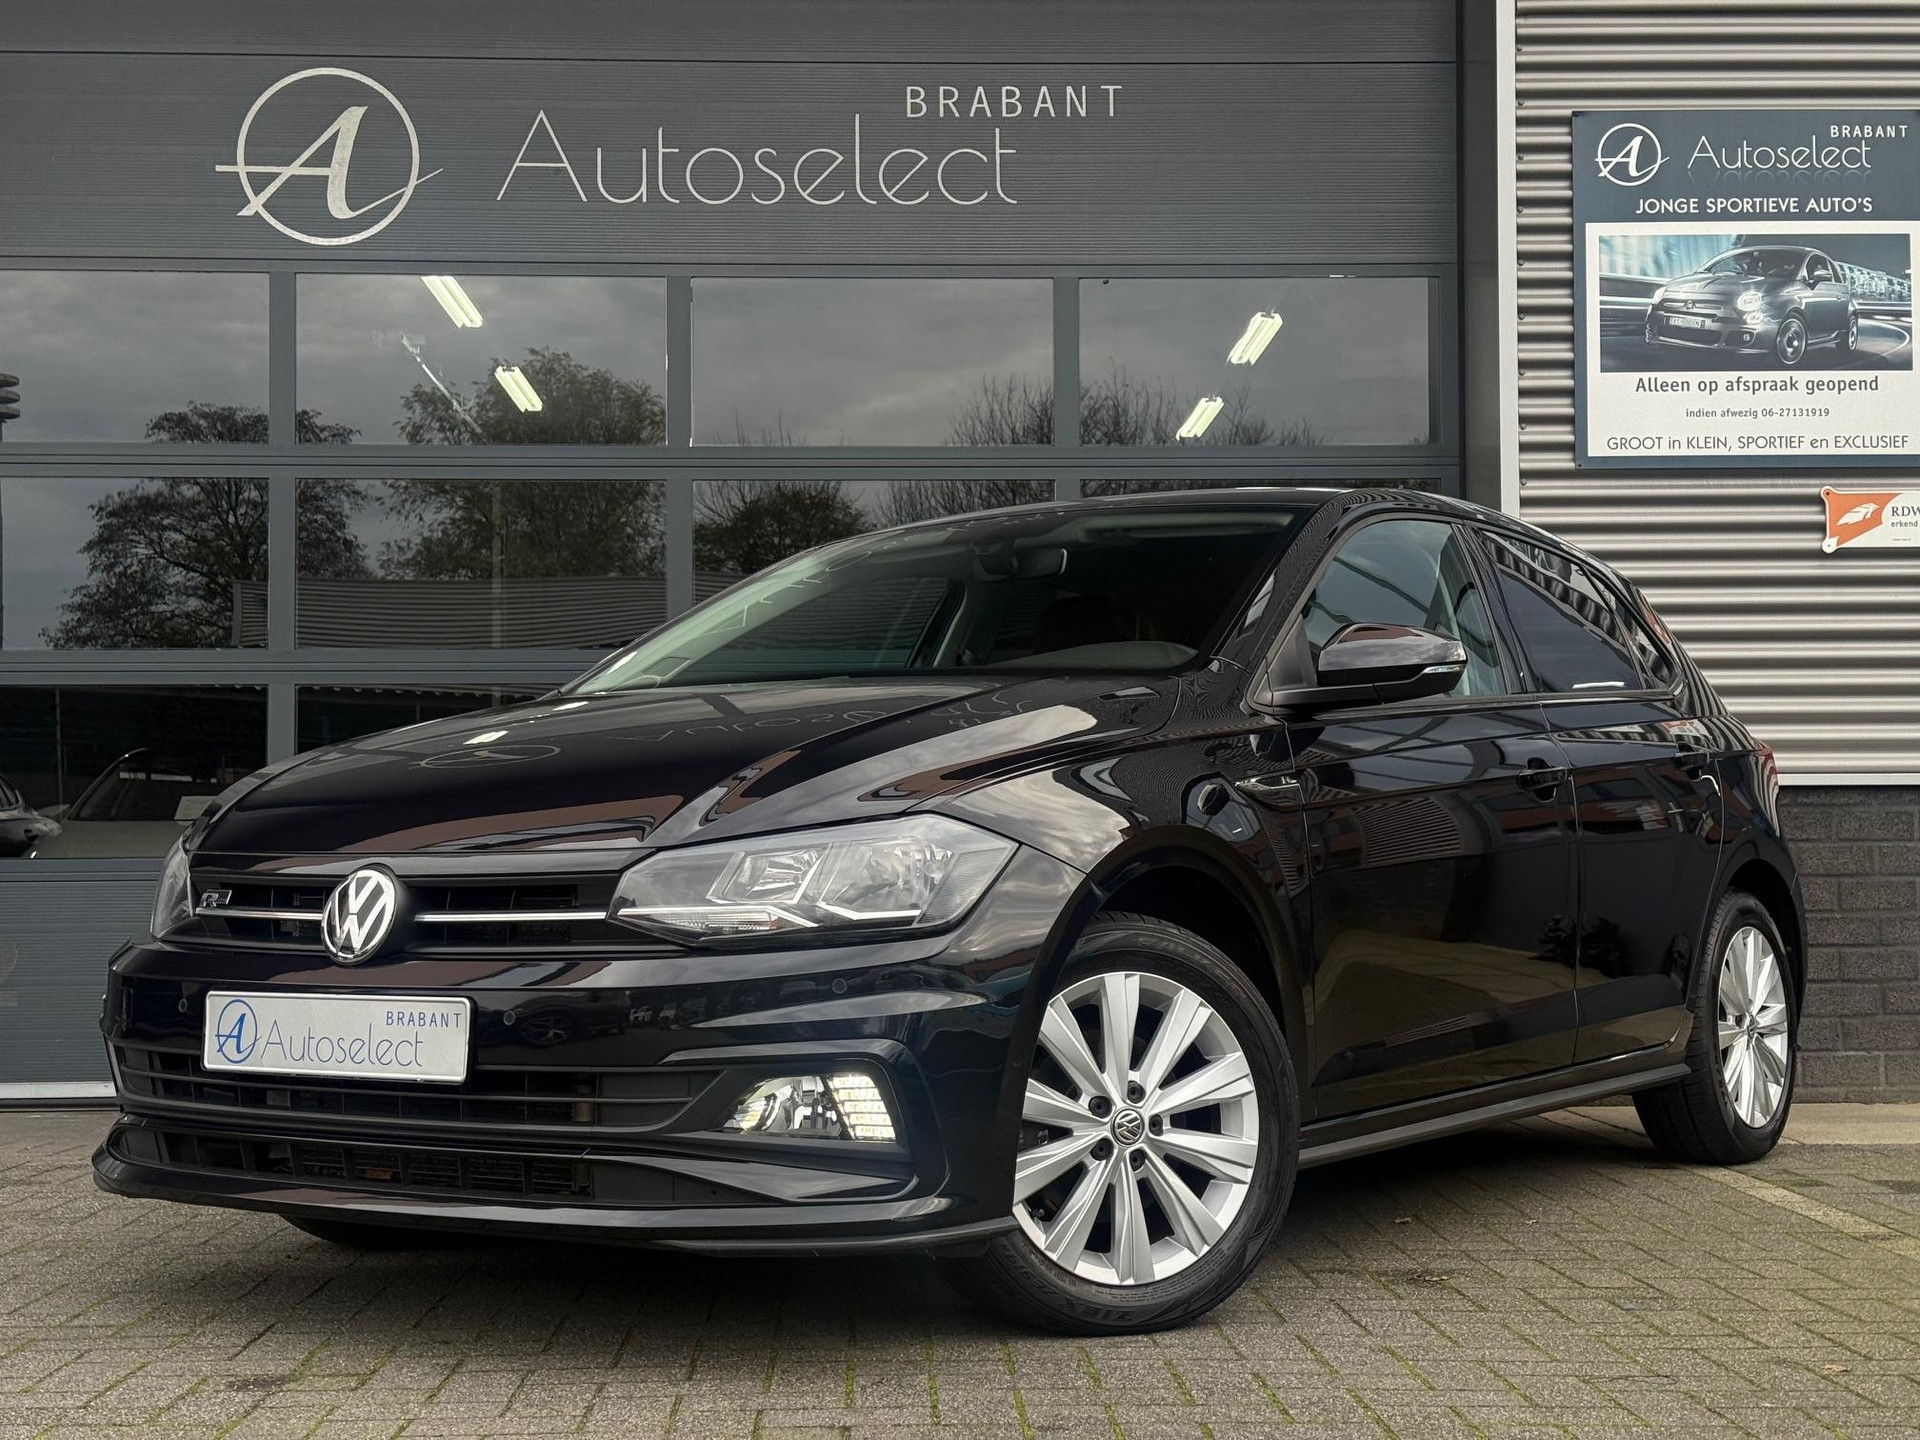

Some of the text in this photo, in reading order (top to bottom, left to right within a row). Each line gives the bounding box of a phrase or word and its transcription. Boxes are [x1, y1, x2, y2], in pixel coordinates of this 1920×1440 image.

[906, 85, 1123, 118] BRABANT
[1830, 125, 1908, 138] BRABANT
[497, 109, 1018, 205] Autoselect
[1687, 135, 1872, 169] Autoselect
[1635, 196, 1873, 214] JONGE SPORTIEVE AUTO'S
[1635, 375, 1879, 396] Alleen op afspraak geopend
[1685, 407, 1830, 419] indien afwezig 06-27131919
[1606, 434, 1909, 453] GROOT in KLEIN, SPORTIEF en EXCLUSIEF
[1890, 519, 1919, 528] erkend
[386, 1010, 462, 1028] BRABANT
[261, 1019, 423, 1068] Autoselect
